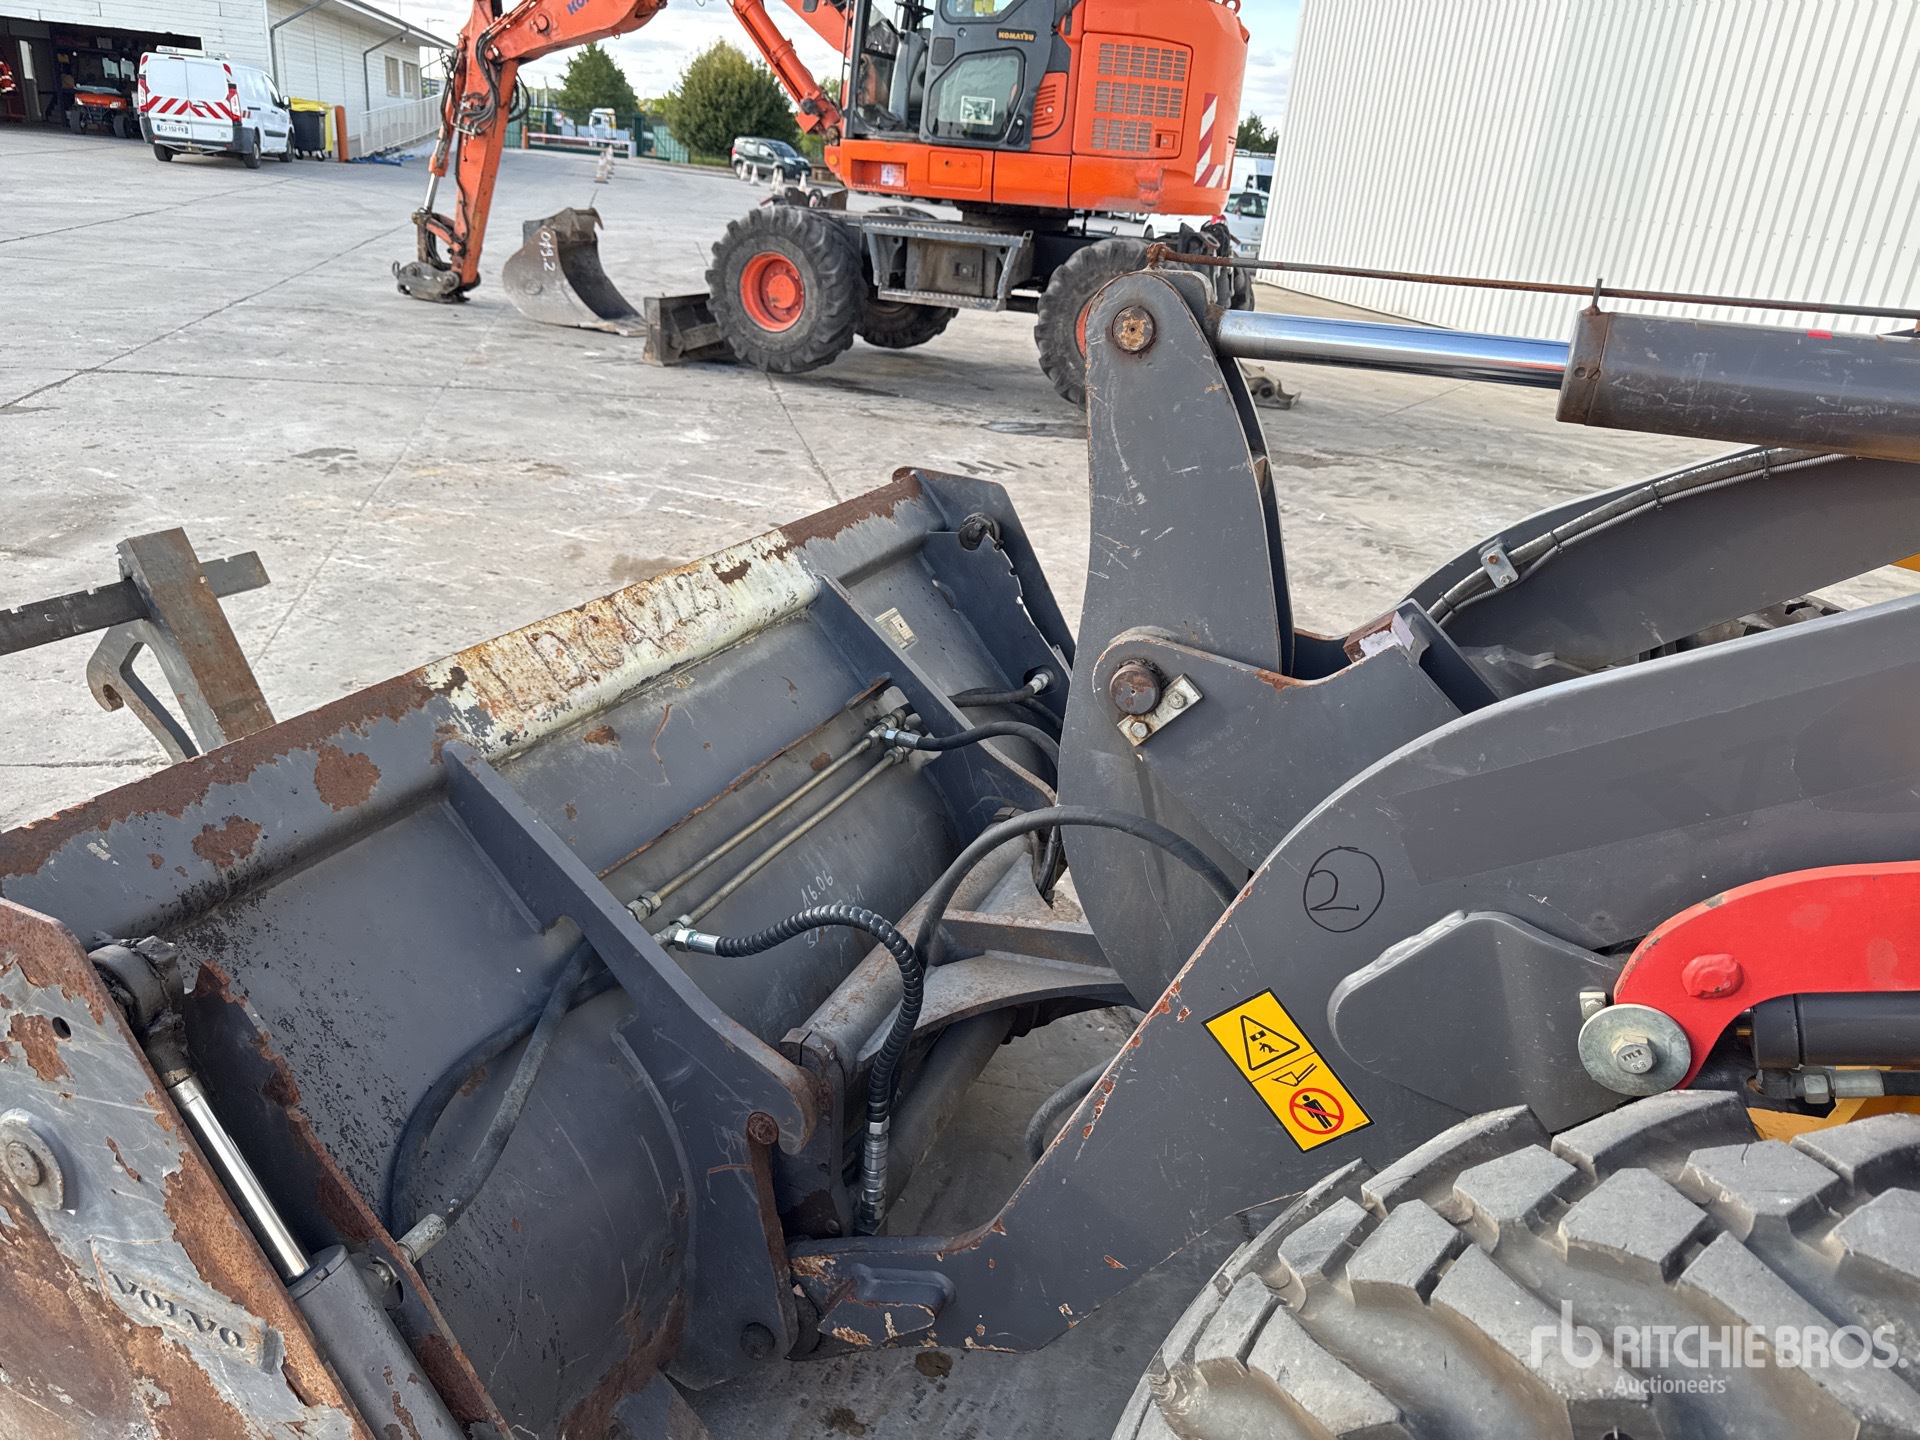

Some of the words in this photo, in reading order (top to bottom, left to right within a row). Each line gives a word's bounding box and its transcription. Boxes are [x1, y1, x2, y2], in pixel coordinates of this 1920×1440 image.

[998, 31, 1035, 41] KOMATSU
[803, 870, 834, 909] 16.06
[1309, 869, 1360, 911] 2
